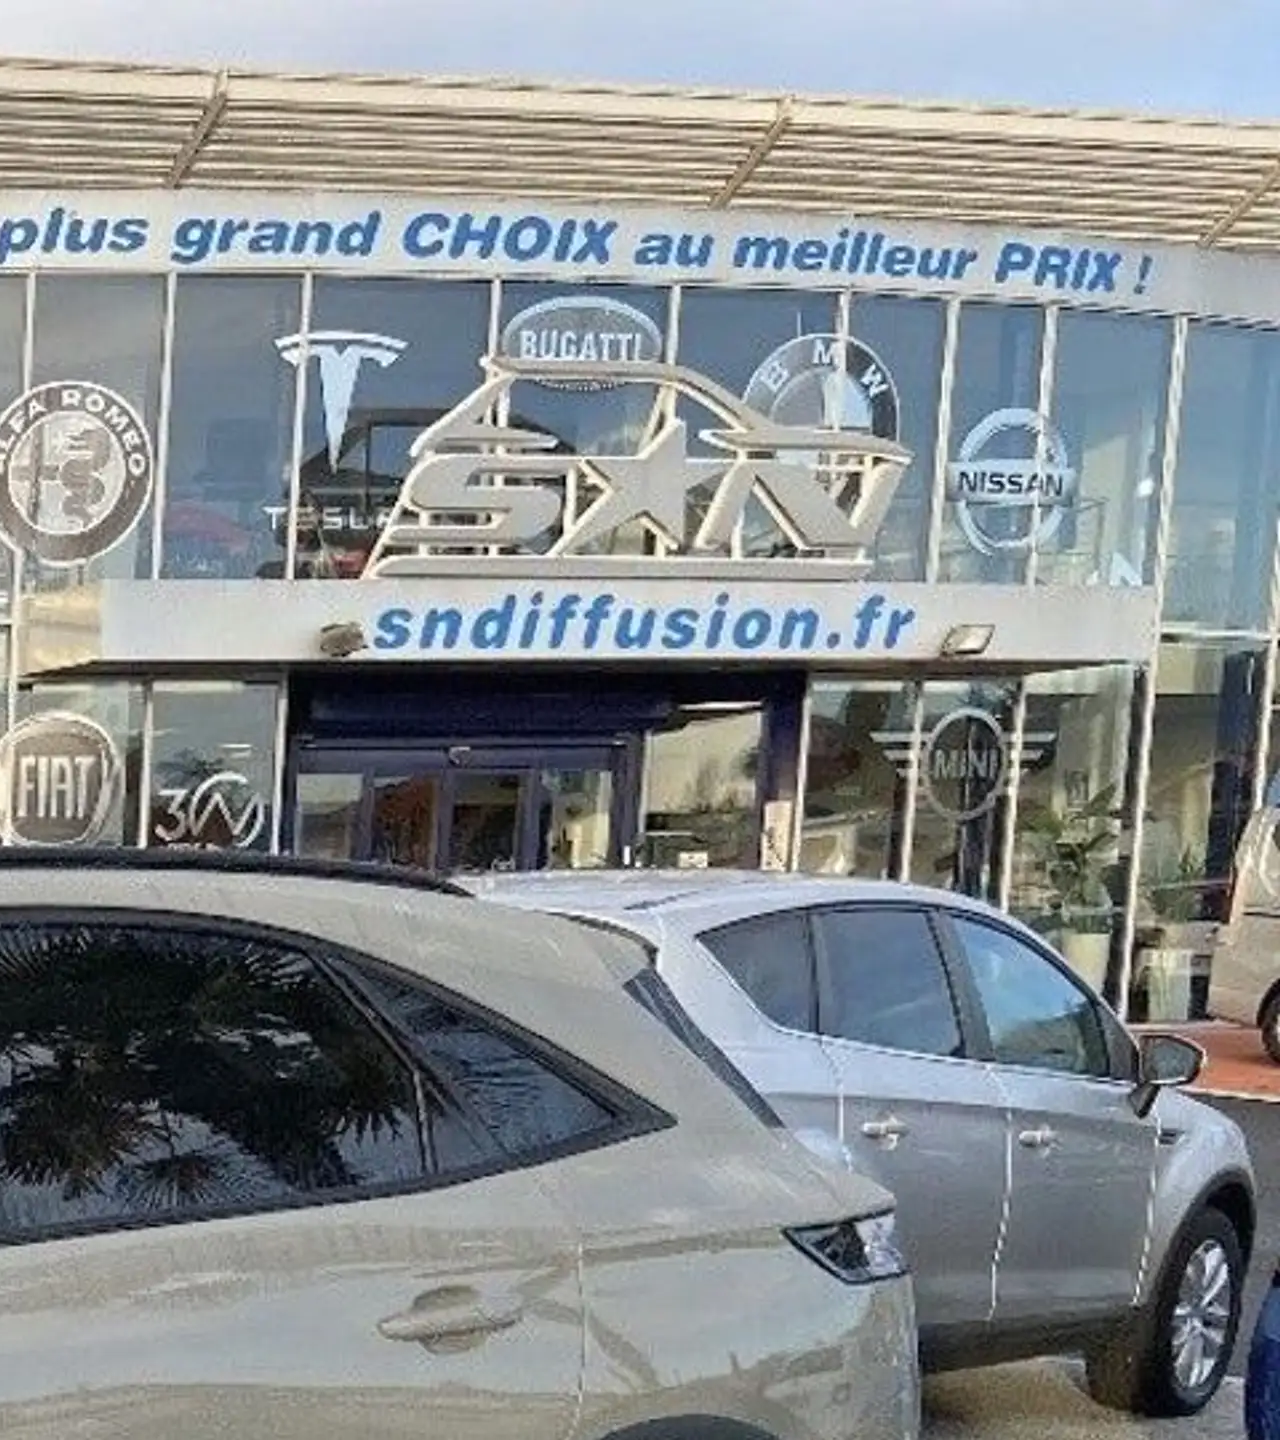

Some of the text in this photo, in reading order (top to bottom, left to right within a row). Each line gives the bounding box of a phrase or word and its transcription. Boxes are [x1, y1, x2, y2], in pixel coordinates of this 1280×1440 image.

[171, 210, 381, 264] grand
[402, 214, 617, 261] CHOIX
[634, 230, 713, 268] au
[733, 229, 977, 281] meilleur
[995, 241, 1124, 294] PRIX
[520, 329, 642, 361] BUGATTI
[760, 338, 889, 399] BMW
[61, 388, 147, 478] ROMEO
[957, 471, 1064, 497] NISSAN
[374, 591, 915, 651] sndiffusion.fr
[16, 755, 98, 820] FIAT
[933, 748, 1000, 781] MINI
